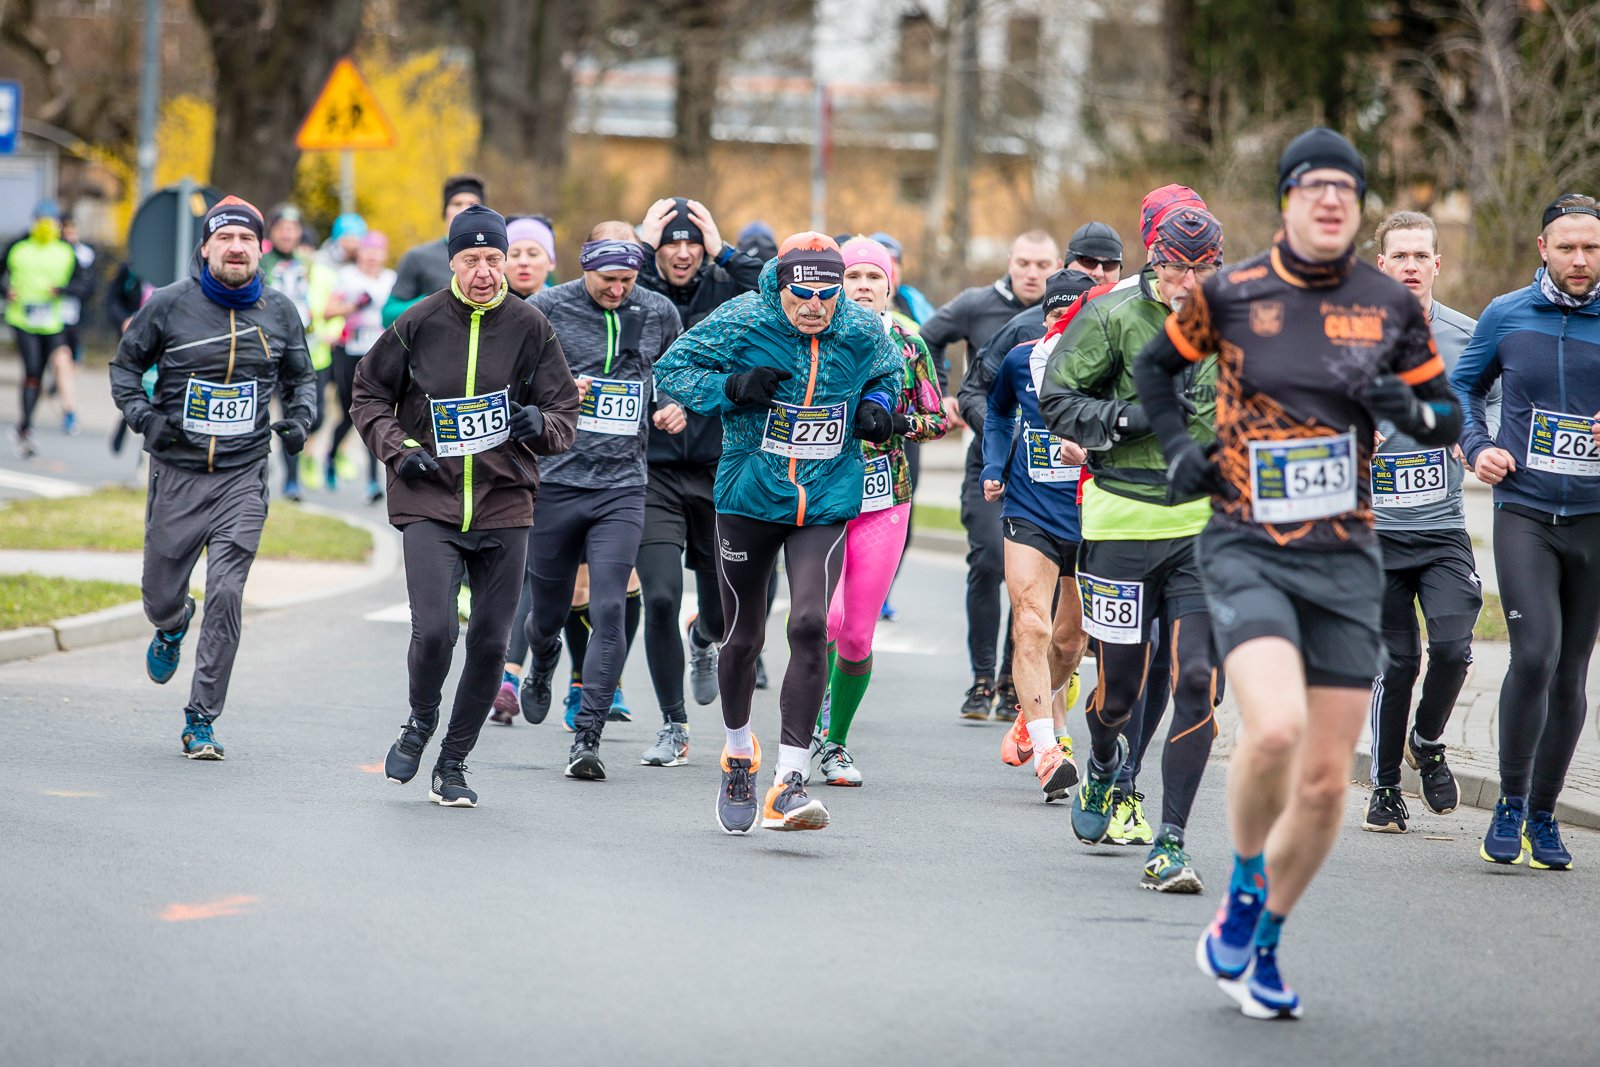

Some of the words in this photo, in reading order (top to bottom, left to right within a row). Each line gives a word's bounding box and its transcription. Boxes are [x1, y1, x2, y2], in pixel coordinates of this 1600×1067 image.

[793, 265, 802, 282] 9
[212, 399, 250, 419] 487
[601, 397, 636, 417] 519
[461, 409, 504, 437] 315
[794, 421, 839, 442] 279
[1557, 432, 1599, 458] 262
[864, 474, 886, 496] 69
[1294, 461, 1346, 494] 543
[1399, 466, 1440, 490] 183
[1095, 597, 1133, 624] 158
